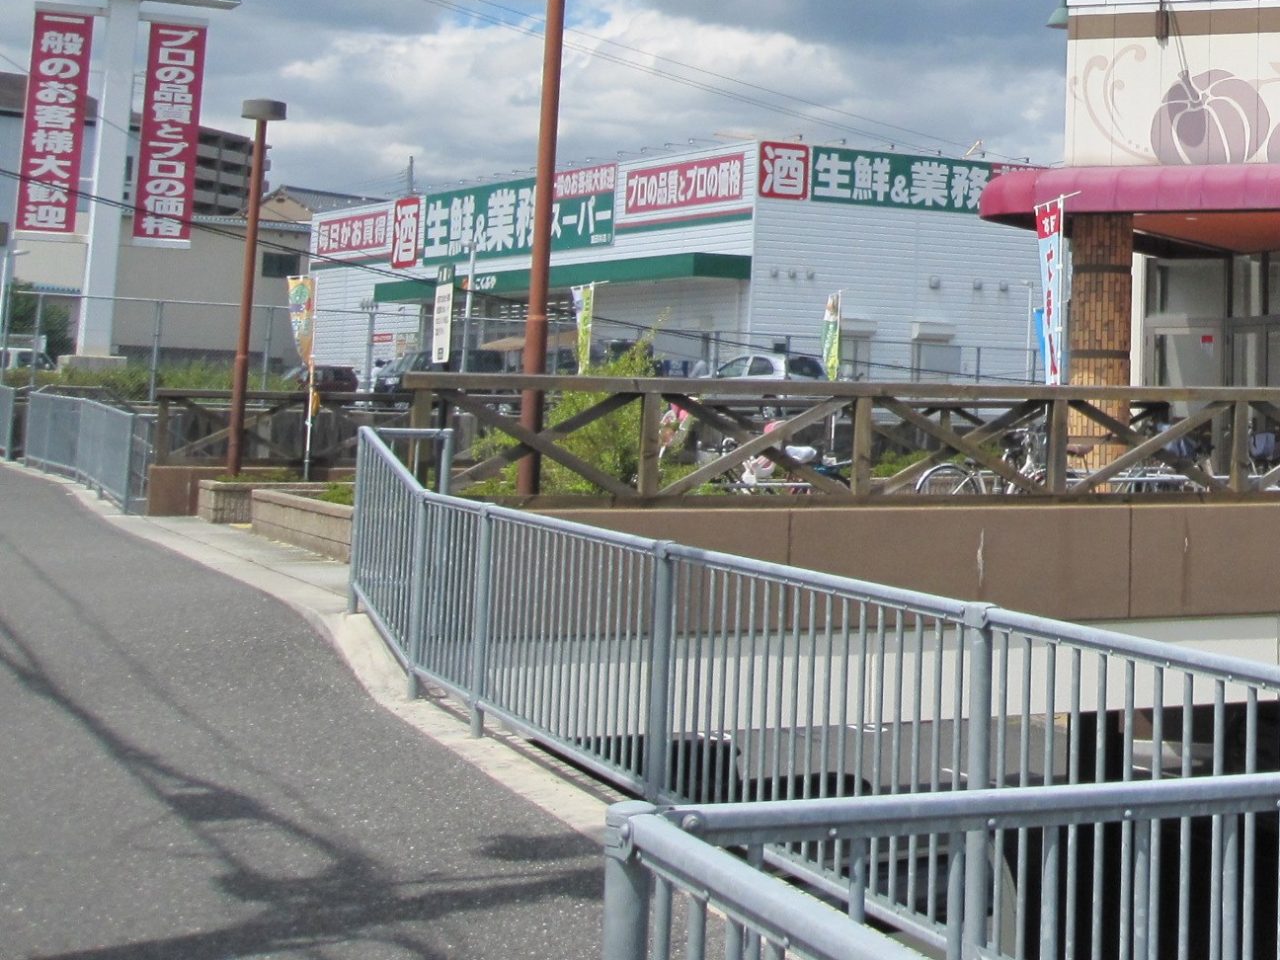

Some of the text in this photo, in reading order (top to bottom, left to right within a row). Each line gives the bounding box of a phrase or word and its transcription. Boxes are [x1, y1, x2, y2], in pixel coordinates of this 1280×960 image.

[24, 15, 85, 229] 一般のお客様大歓迎
[141, 28, 198, 236] プロの品質とプロの価格
[627, 159, 741, 208] プロの品質とプロの価格
[762, 145, 806, 194] 酒
[319, 215, 387, 251] 毎日がお買得
[393, 204, 419, 263] 酒
